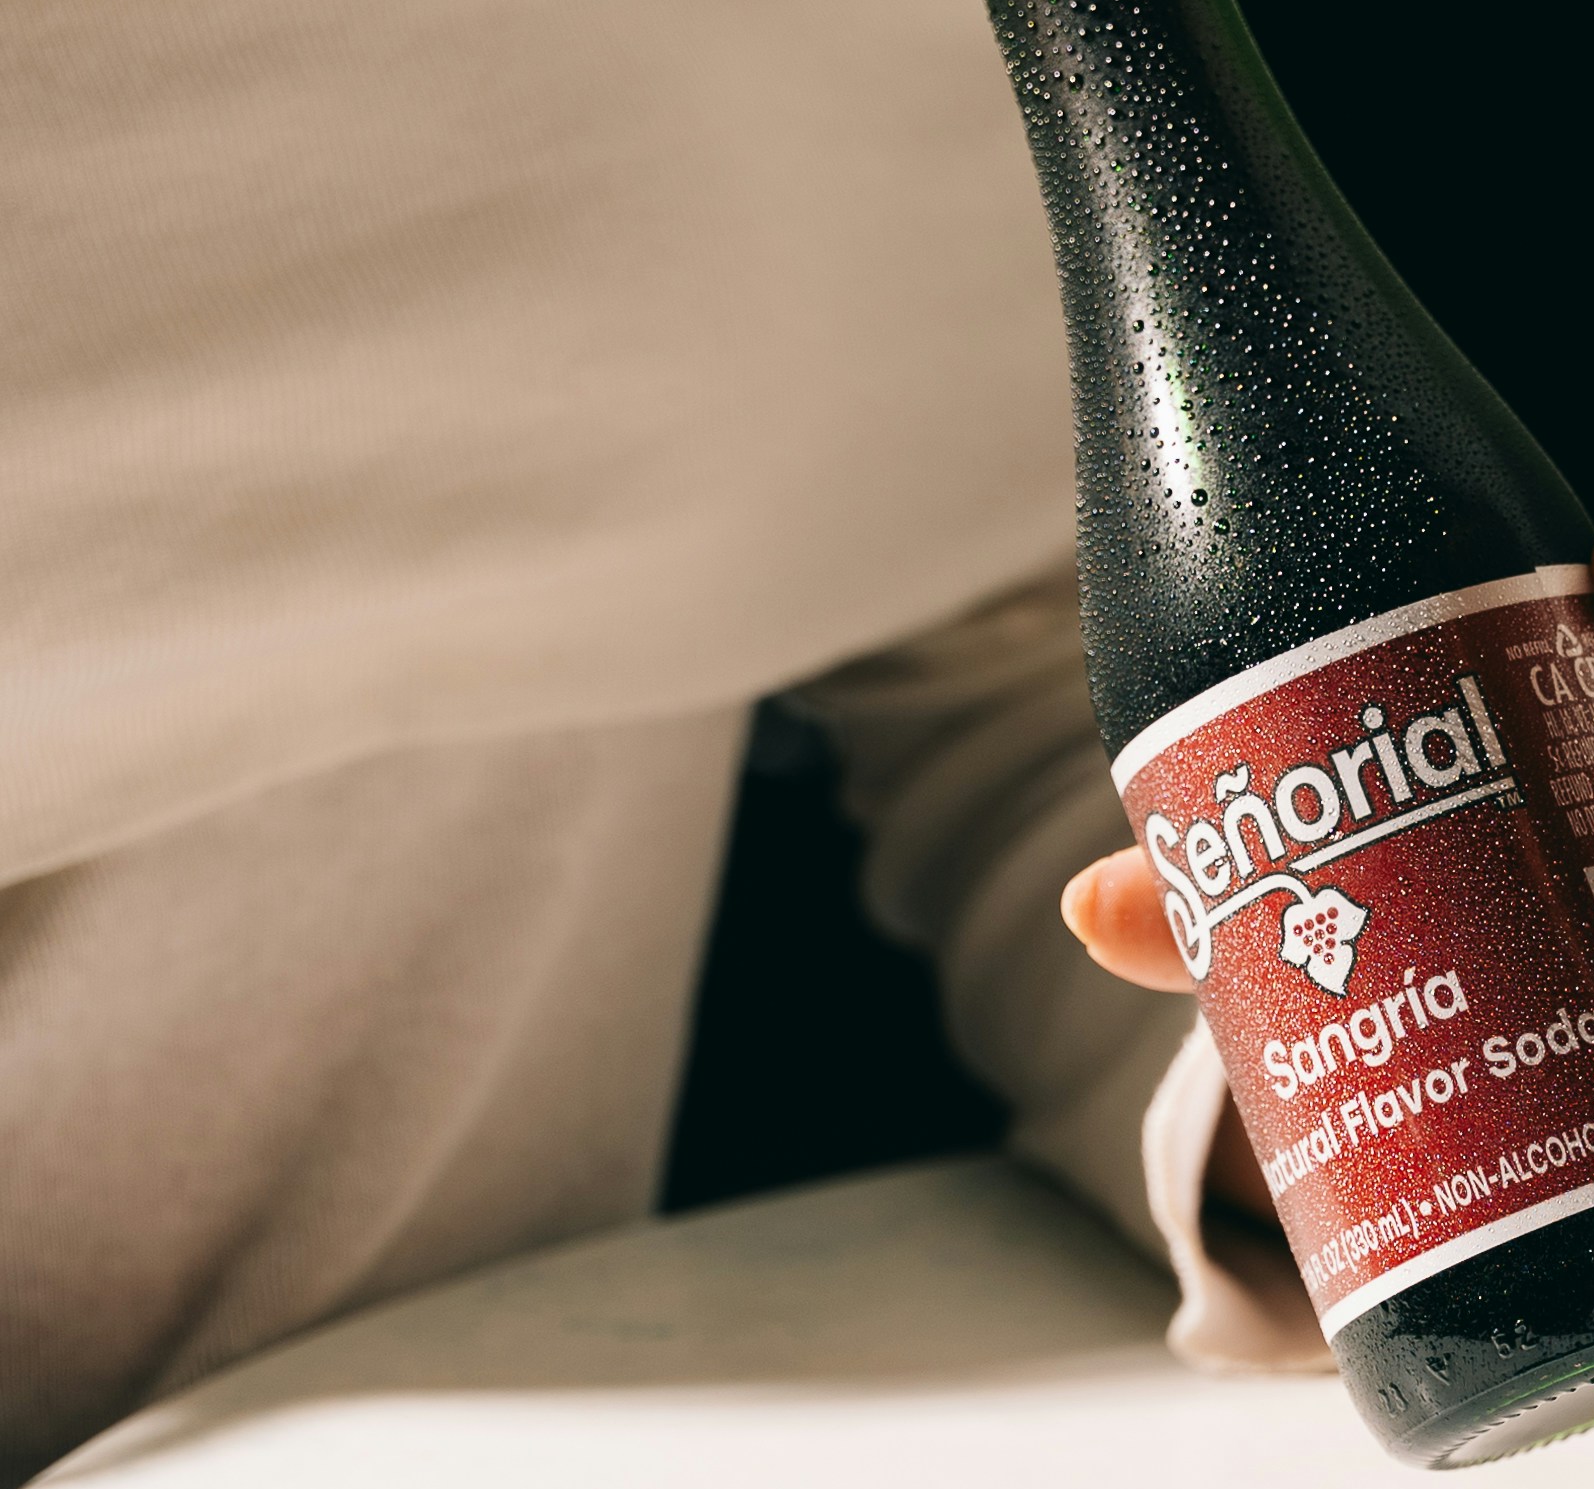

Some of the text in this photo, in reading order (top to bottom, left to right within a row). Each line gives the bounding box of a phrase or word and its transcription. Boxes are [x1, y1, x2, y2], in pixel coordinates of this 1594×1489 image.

[1529, 663, 1574, 707] CA
[1145, 675, 1507, 981] Señorial
[1262, 967, 1470, 1102] Sangría
[1338, 1057, 1471, 1150] Flavor
[1340, 1219, 1379, 1274] (330
[1378, 1197, 1419, 1244] mL)
